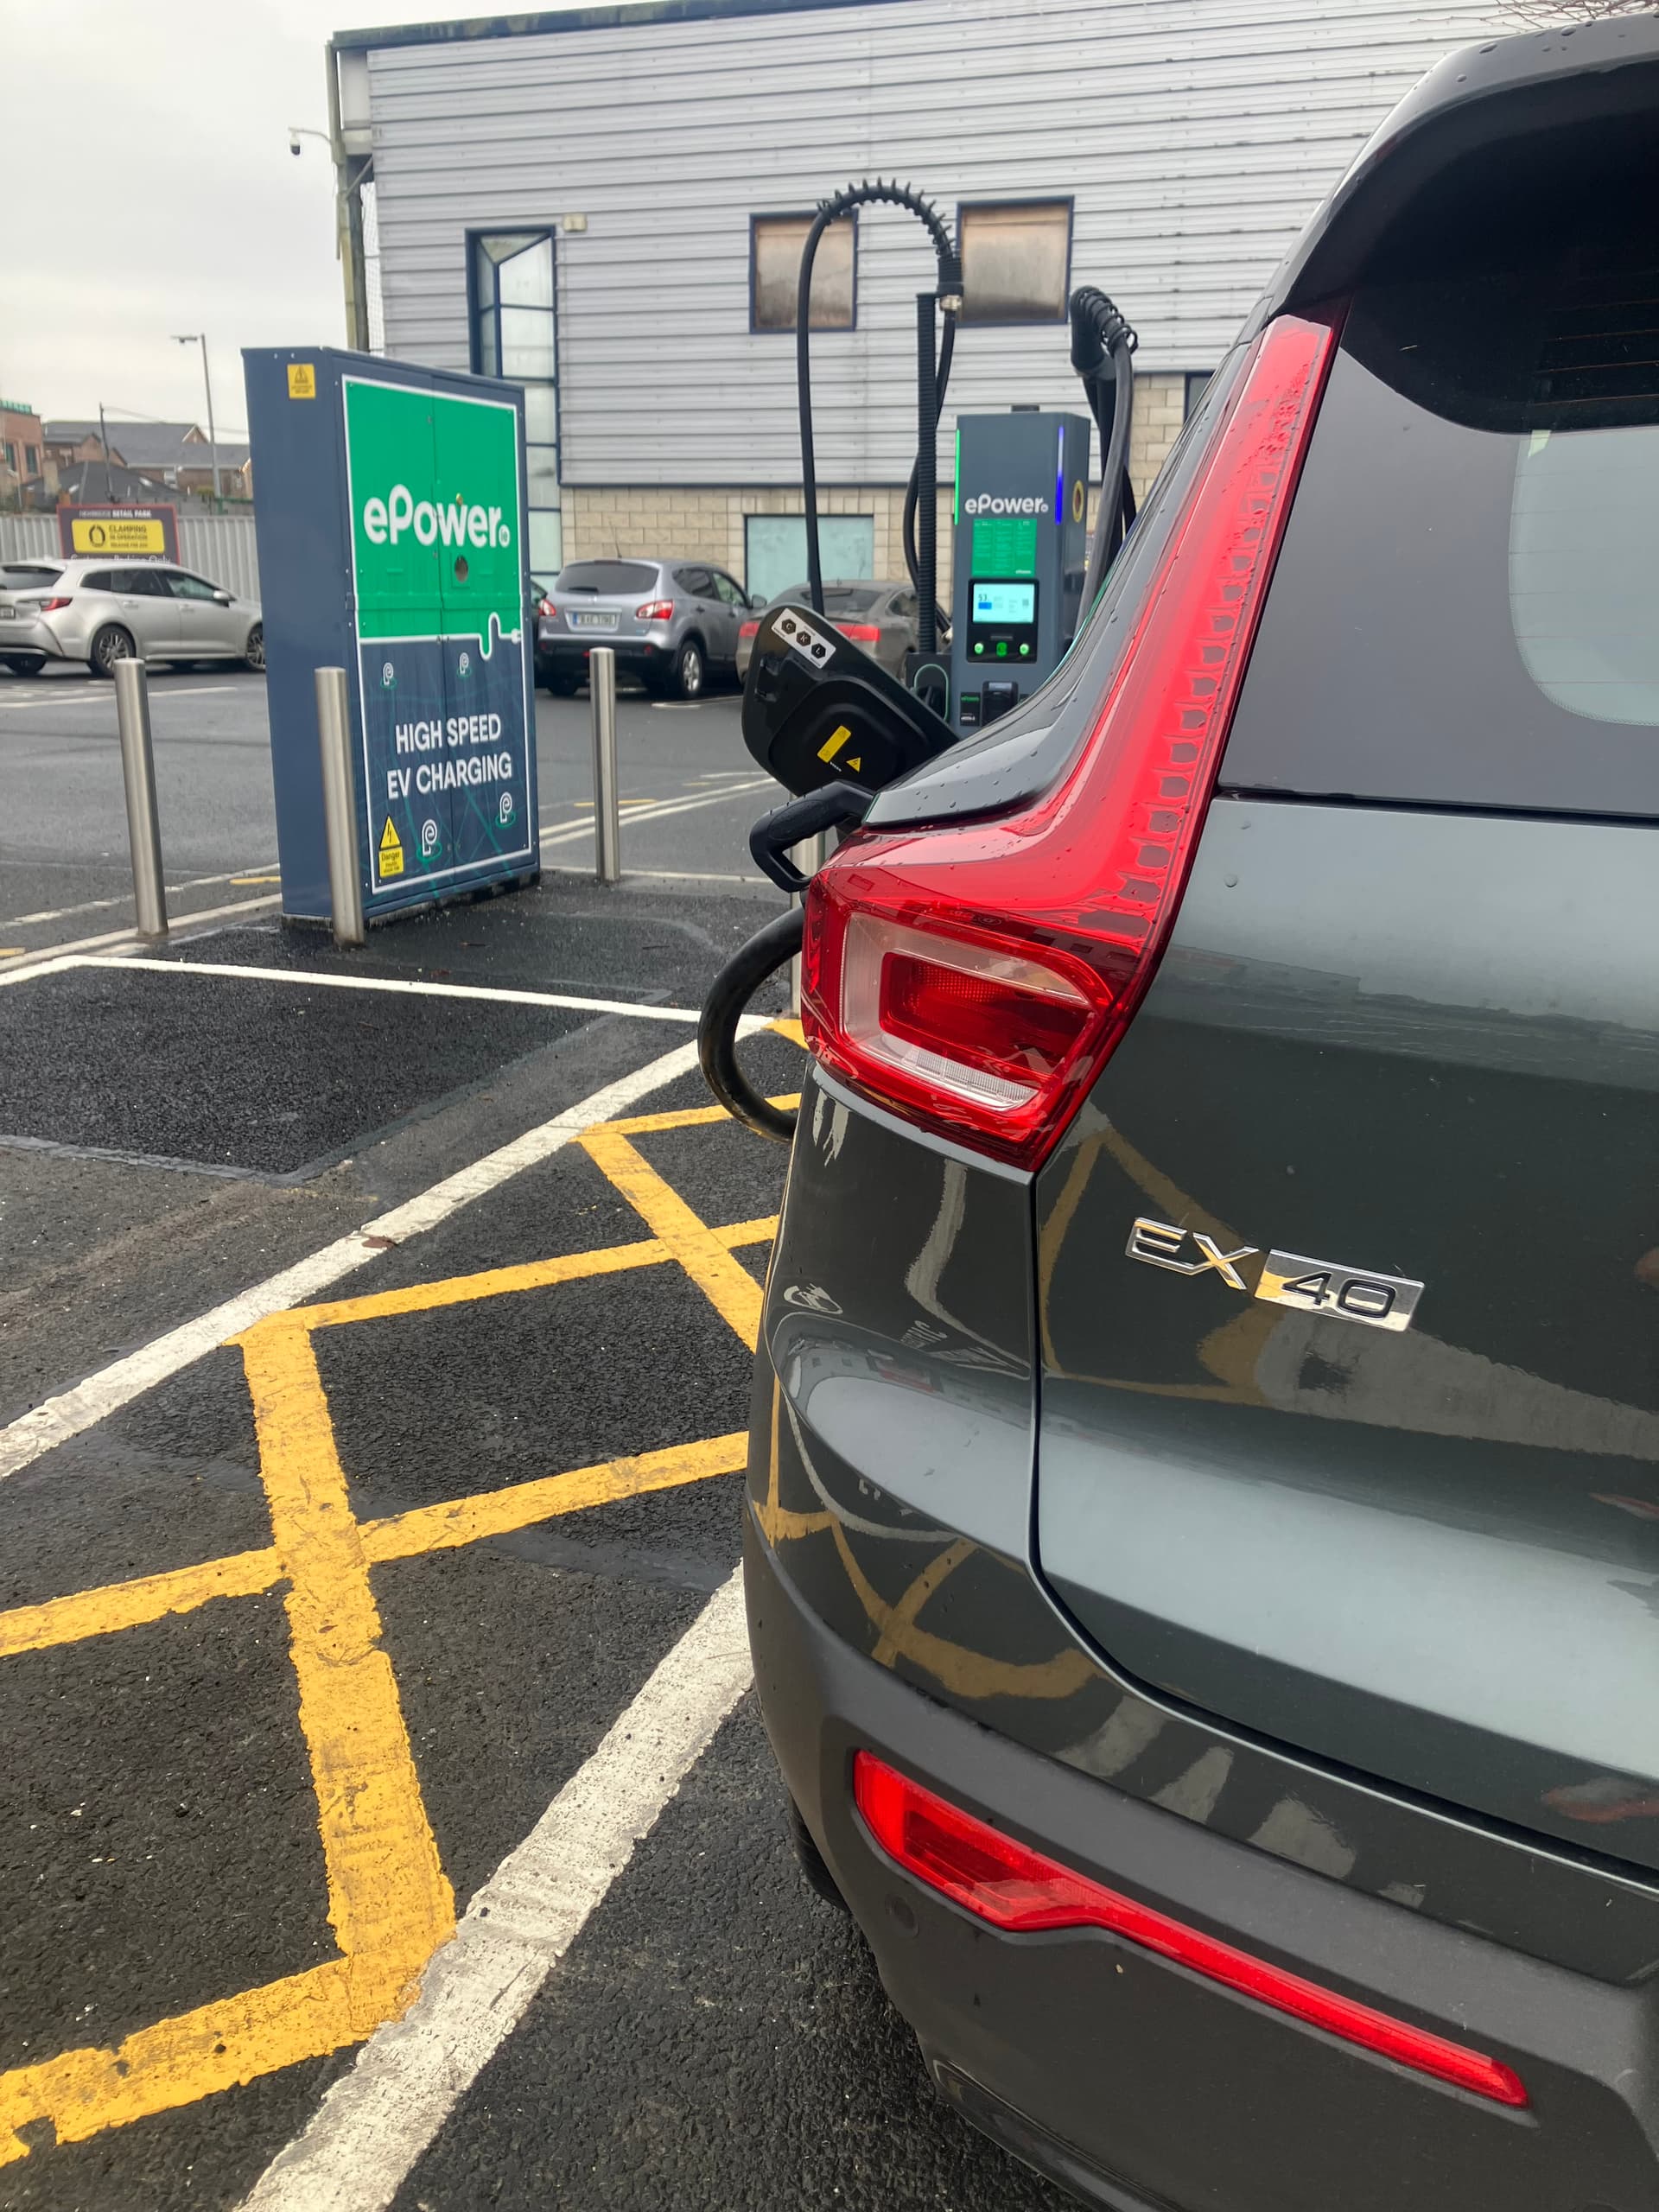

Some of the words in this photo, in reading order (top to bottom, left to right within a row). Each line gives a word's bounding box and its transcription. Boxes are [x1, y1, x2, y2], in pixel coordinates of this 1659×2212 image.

[109, 524, 147, 533] CLAMPING
[395, 720, 442, 754] HIGH
[446, 713, 502, 747] SPEED
[386, 768, 411, 800] EV
[416, 752, 512, 795] CHARGING
